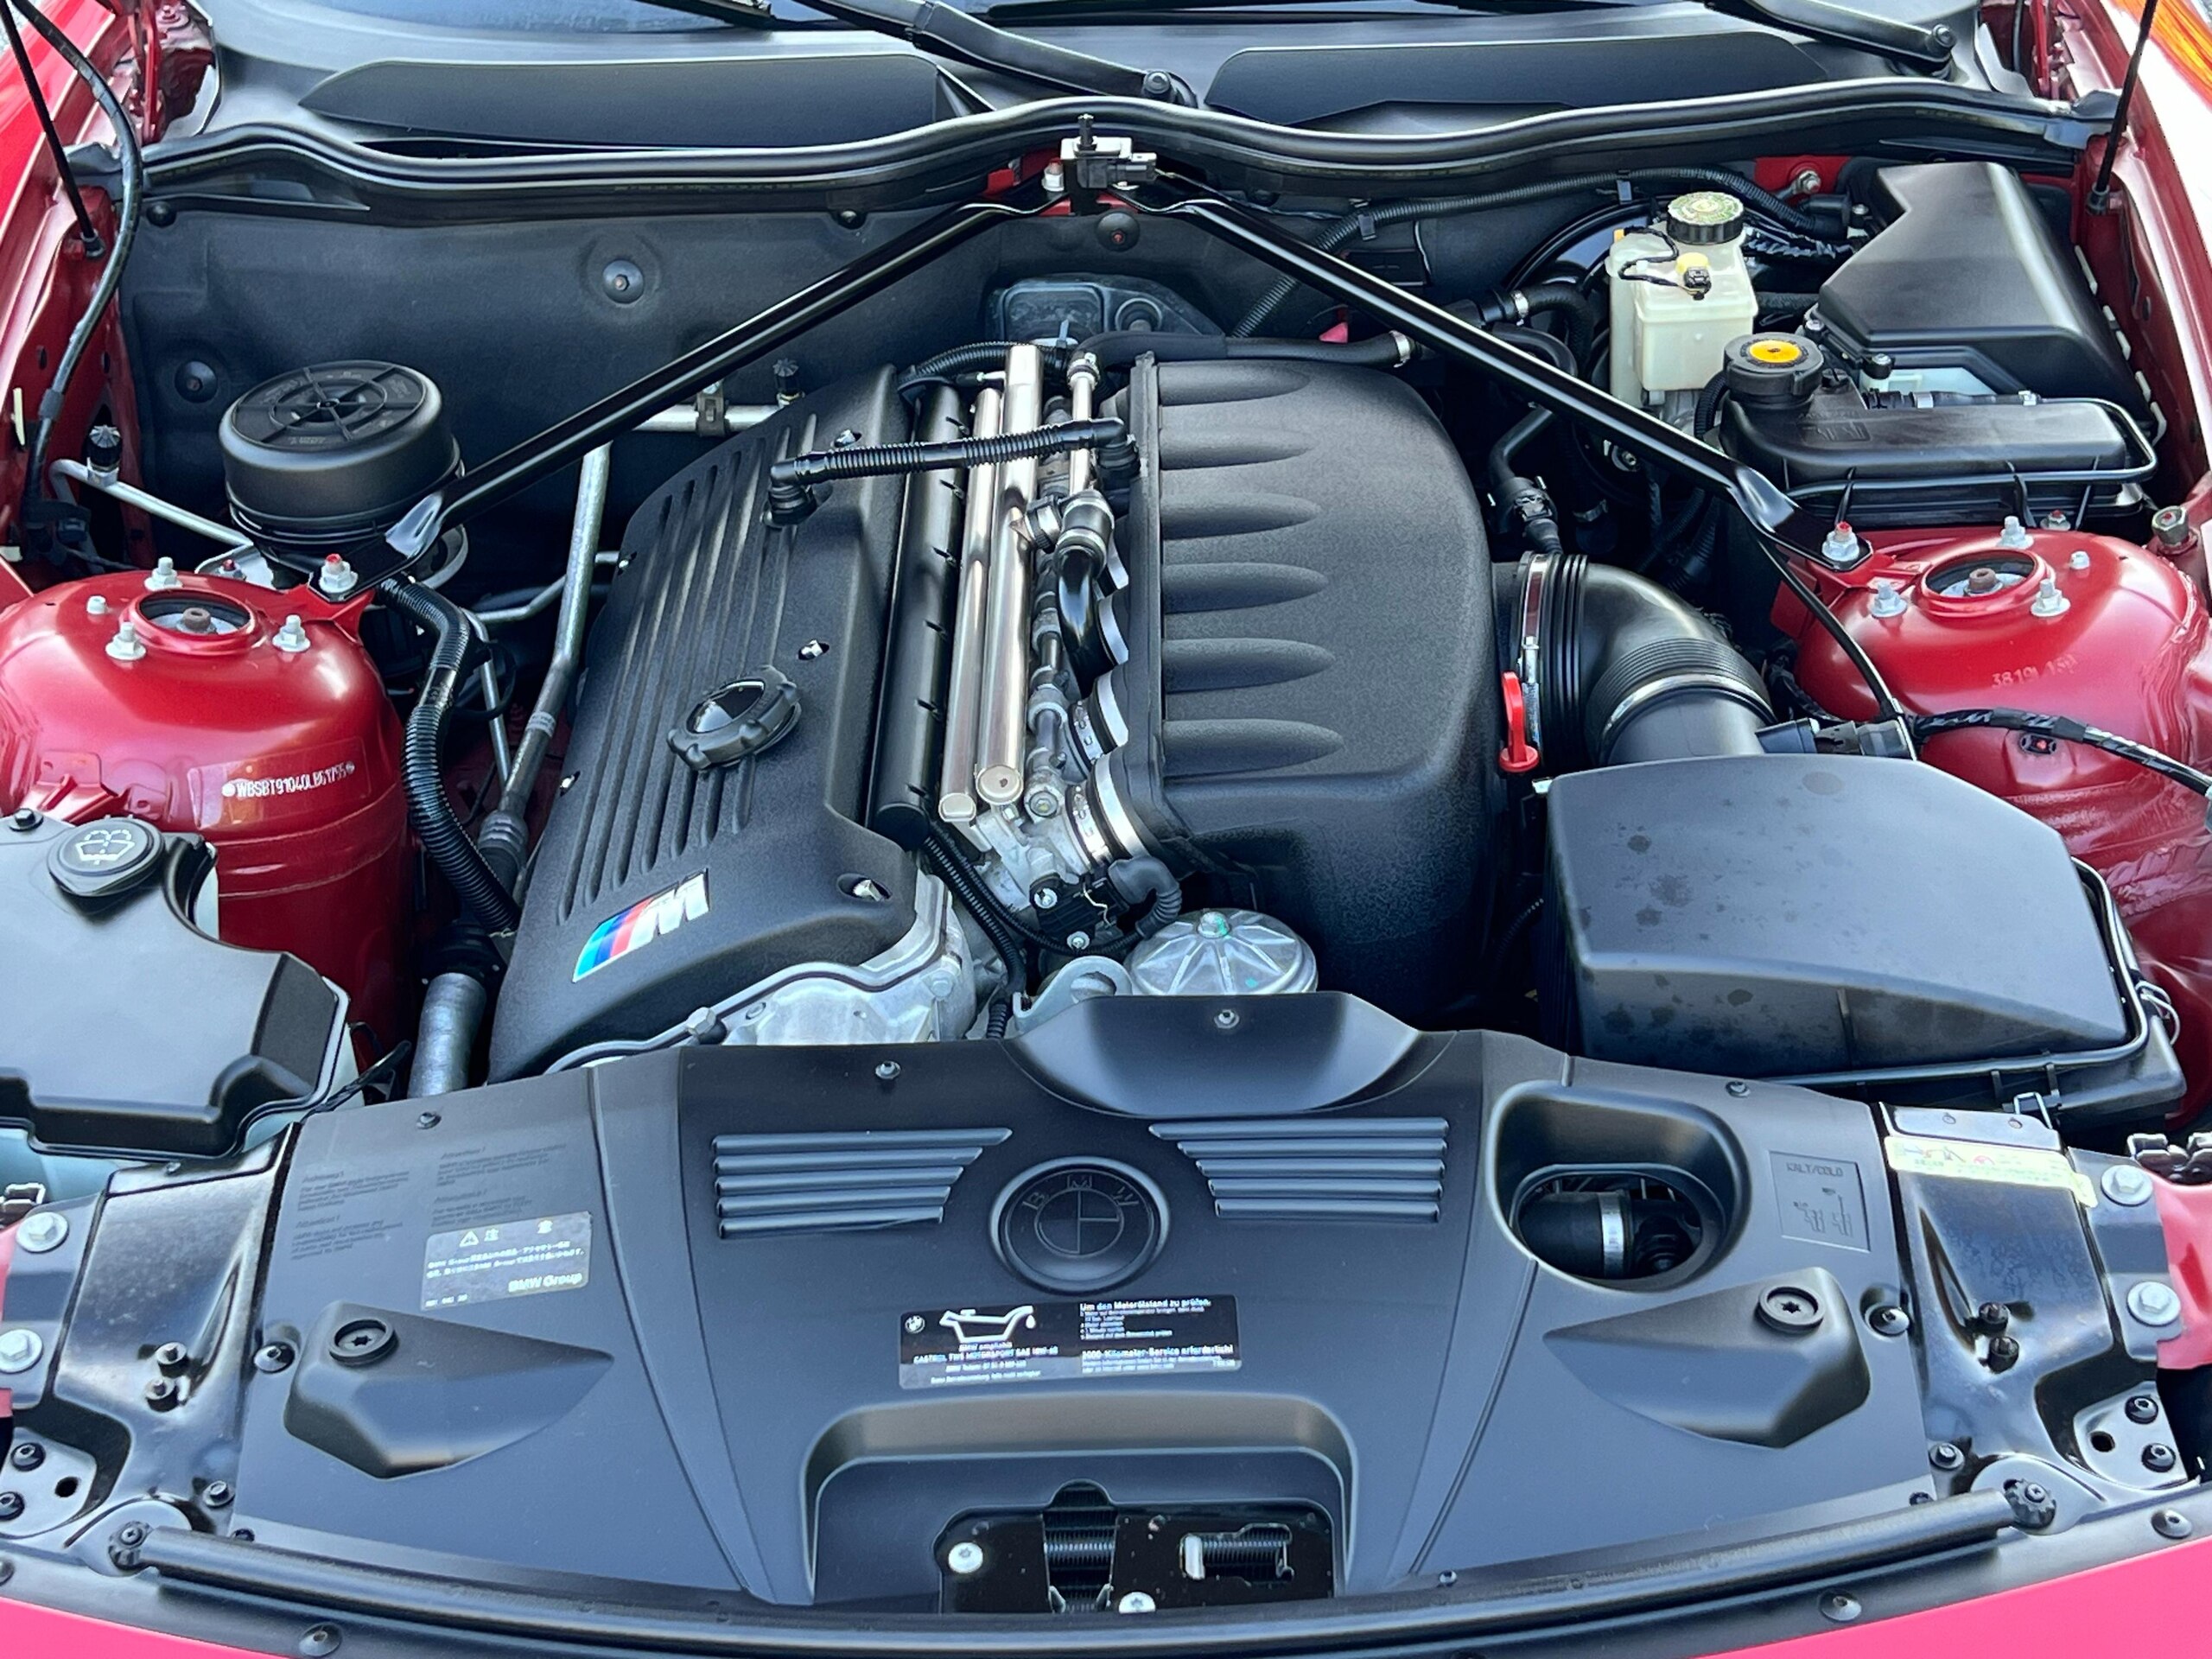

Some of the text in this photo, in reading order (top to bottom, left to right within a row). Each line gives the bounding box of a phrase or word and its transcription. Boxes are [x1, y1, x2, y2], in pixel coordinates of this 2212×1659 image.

[1022, 1174, 1140, 1210] BMW
[508, 1272, 582, 1293] BMW Group
